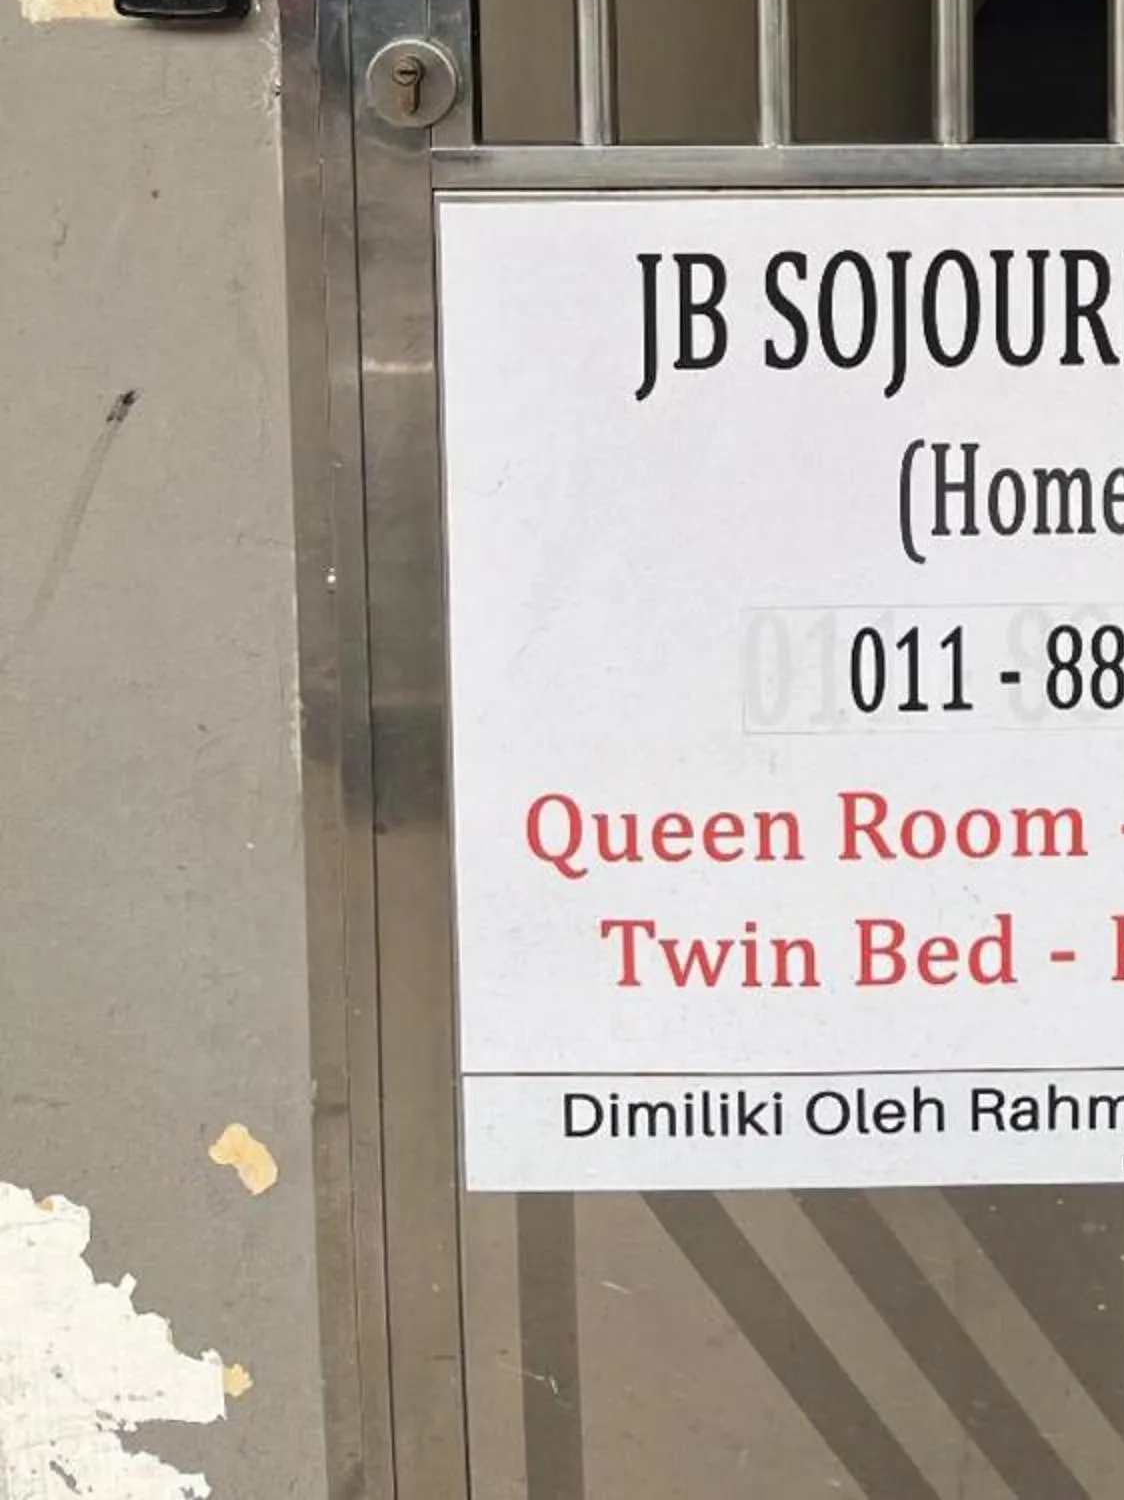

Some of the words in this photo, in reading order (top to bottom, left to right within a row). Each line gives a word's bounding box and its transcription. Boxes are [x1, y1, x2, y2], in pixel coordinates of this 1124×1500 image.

[635, 253, 728, 402] JB
[850, 625, 973, 714] 011
[525, 793, 801, 880] Queen
[839, 789, 1088, 862] Room
[599, 917, 820, 989] Twin
[856, 913, 1017, 988] Bed
[1051, 950, 1077, 962] -
[563, 1090, 783, 1138] Dimiliki
[805, 1086, 945, 1136] Oleh
